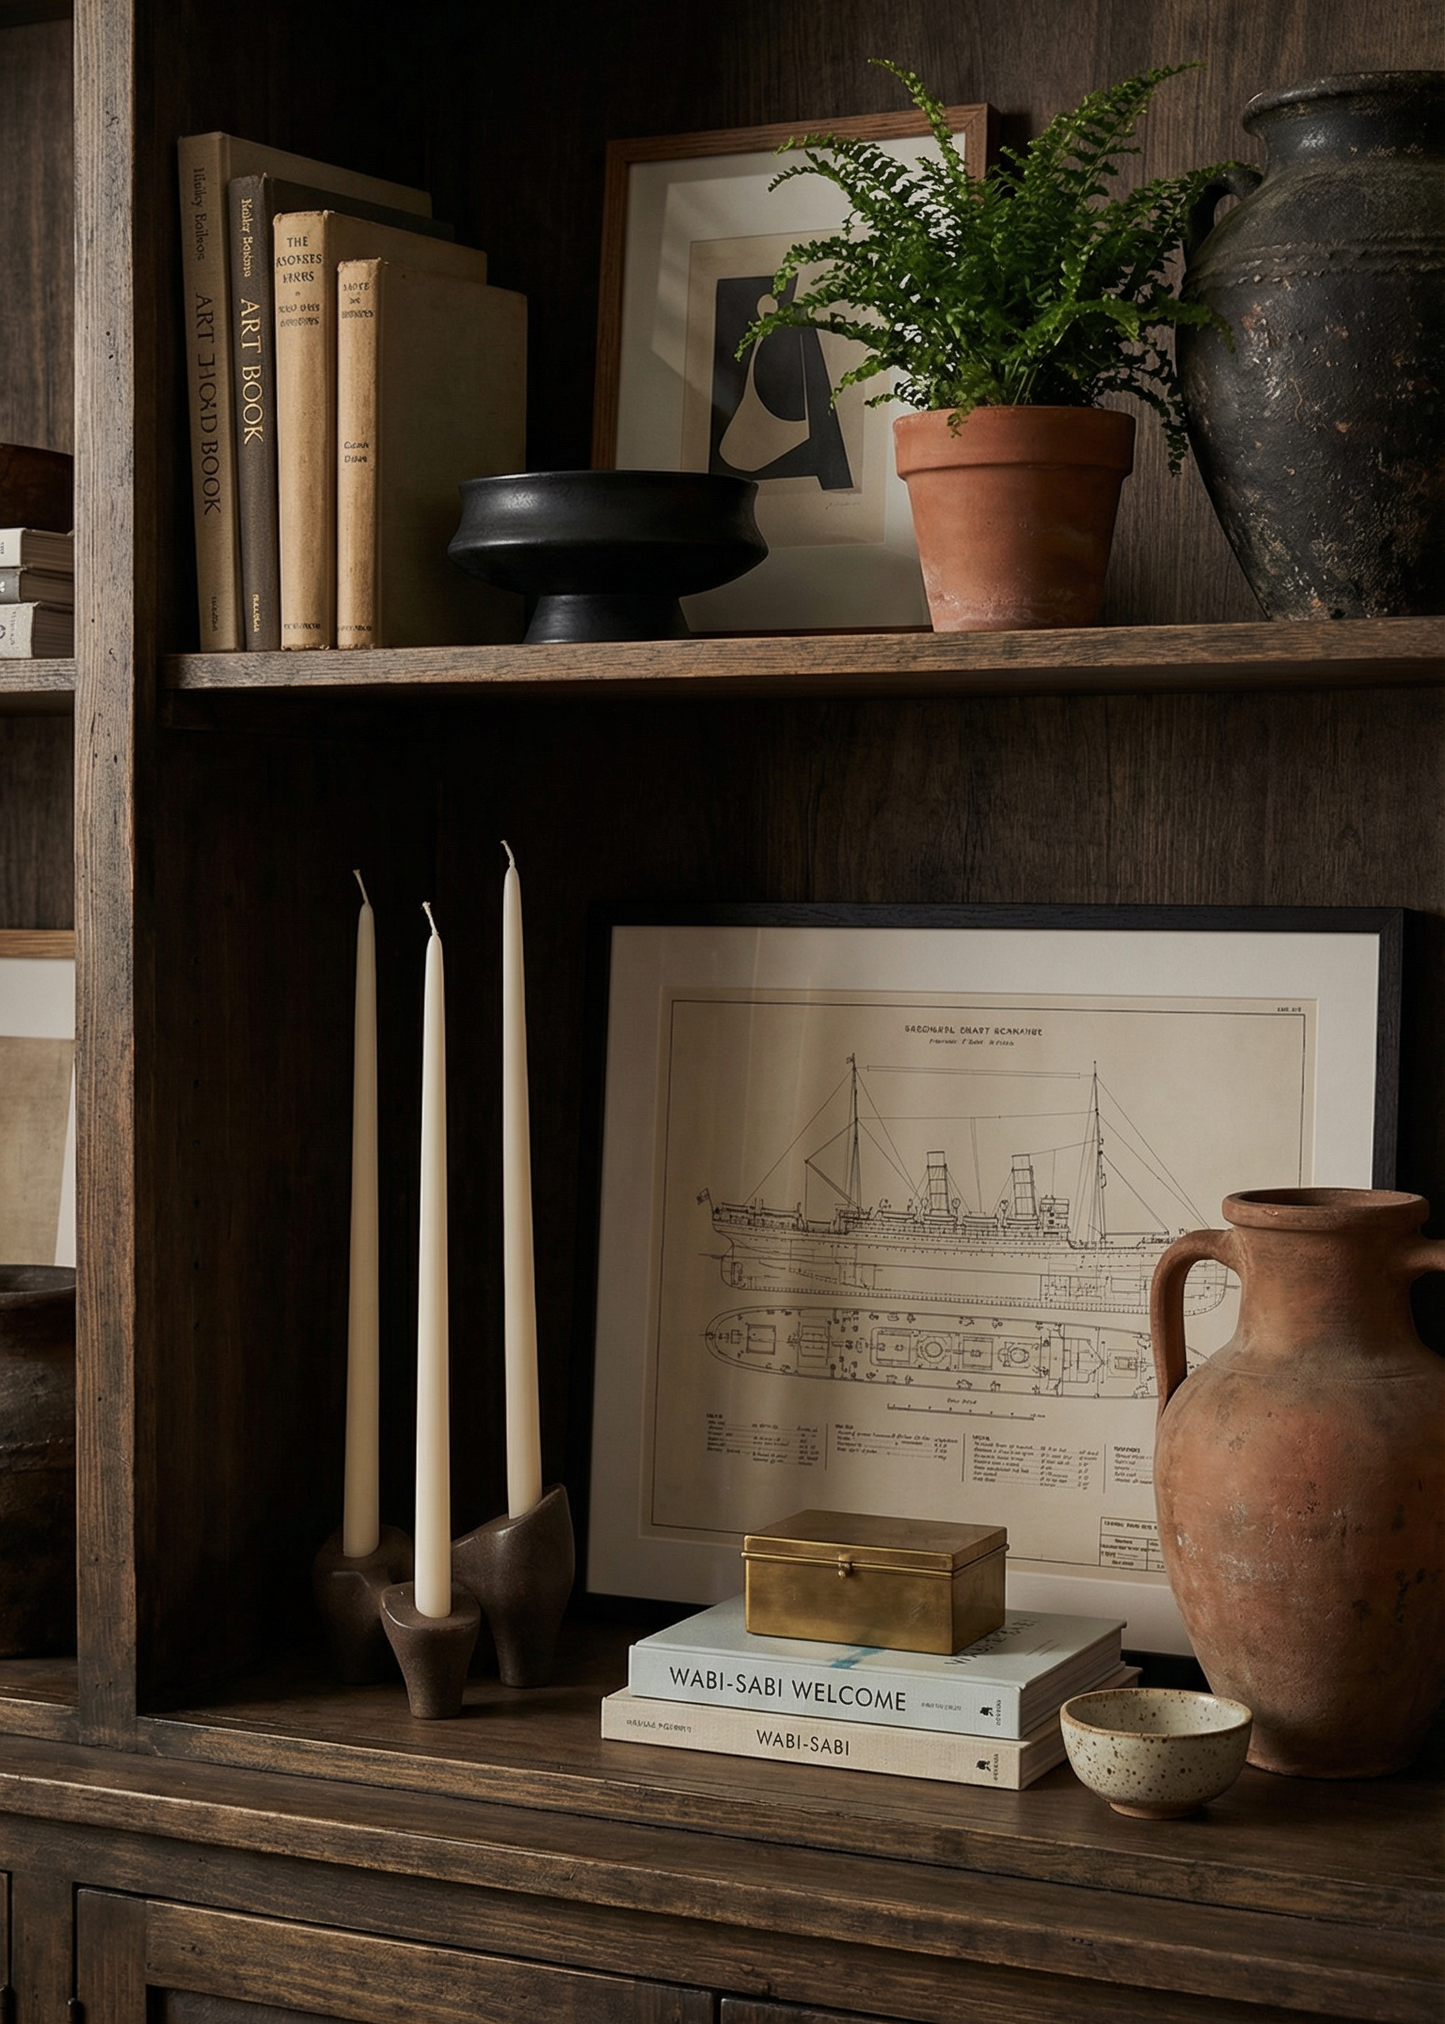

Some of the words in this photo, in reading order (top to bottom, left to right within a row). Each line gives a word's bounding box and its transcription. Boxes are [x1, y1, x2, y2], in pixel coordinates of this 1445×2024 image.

[287, 236, 309, 248] THE
[195, 292, 216, 344] ART
[240, 298, 262, 354] ART
[242, 365, 264, 445] BOOK
[201, 440, 221, 516] BOOK
[669, 1666, 782, 1698] WABI-SABI
[792, 1679, 906, 1712] WELCOME
[756, 1729, 850, 1756] WABI-SABI
